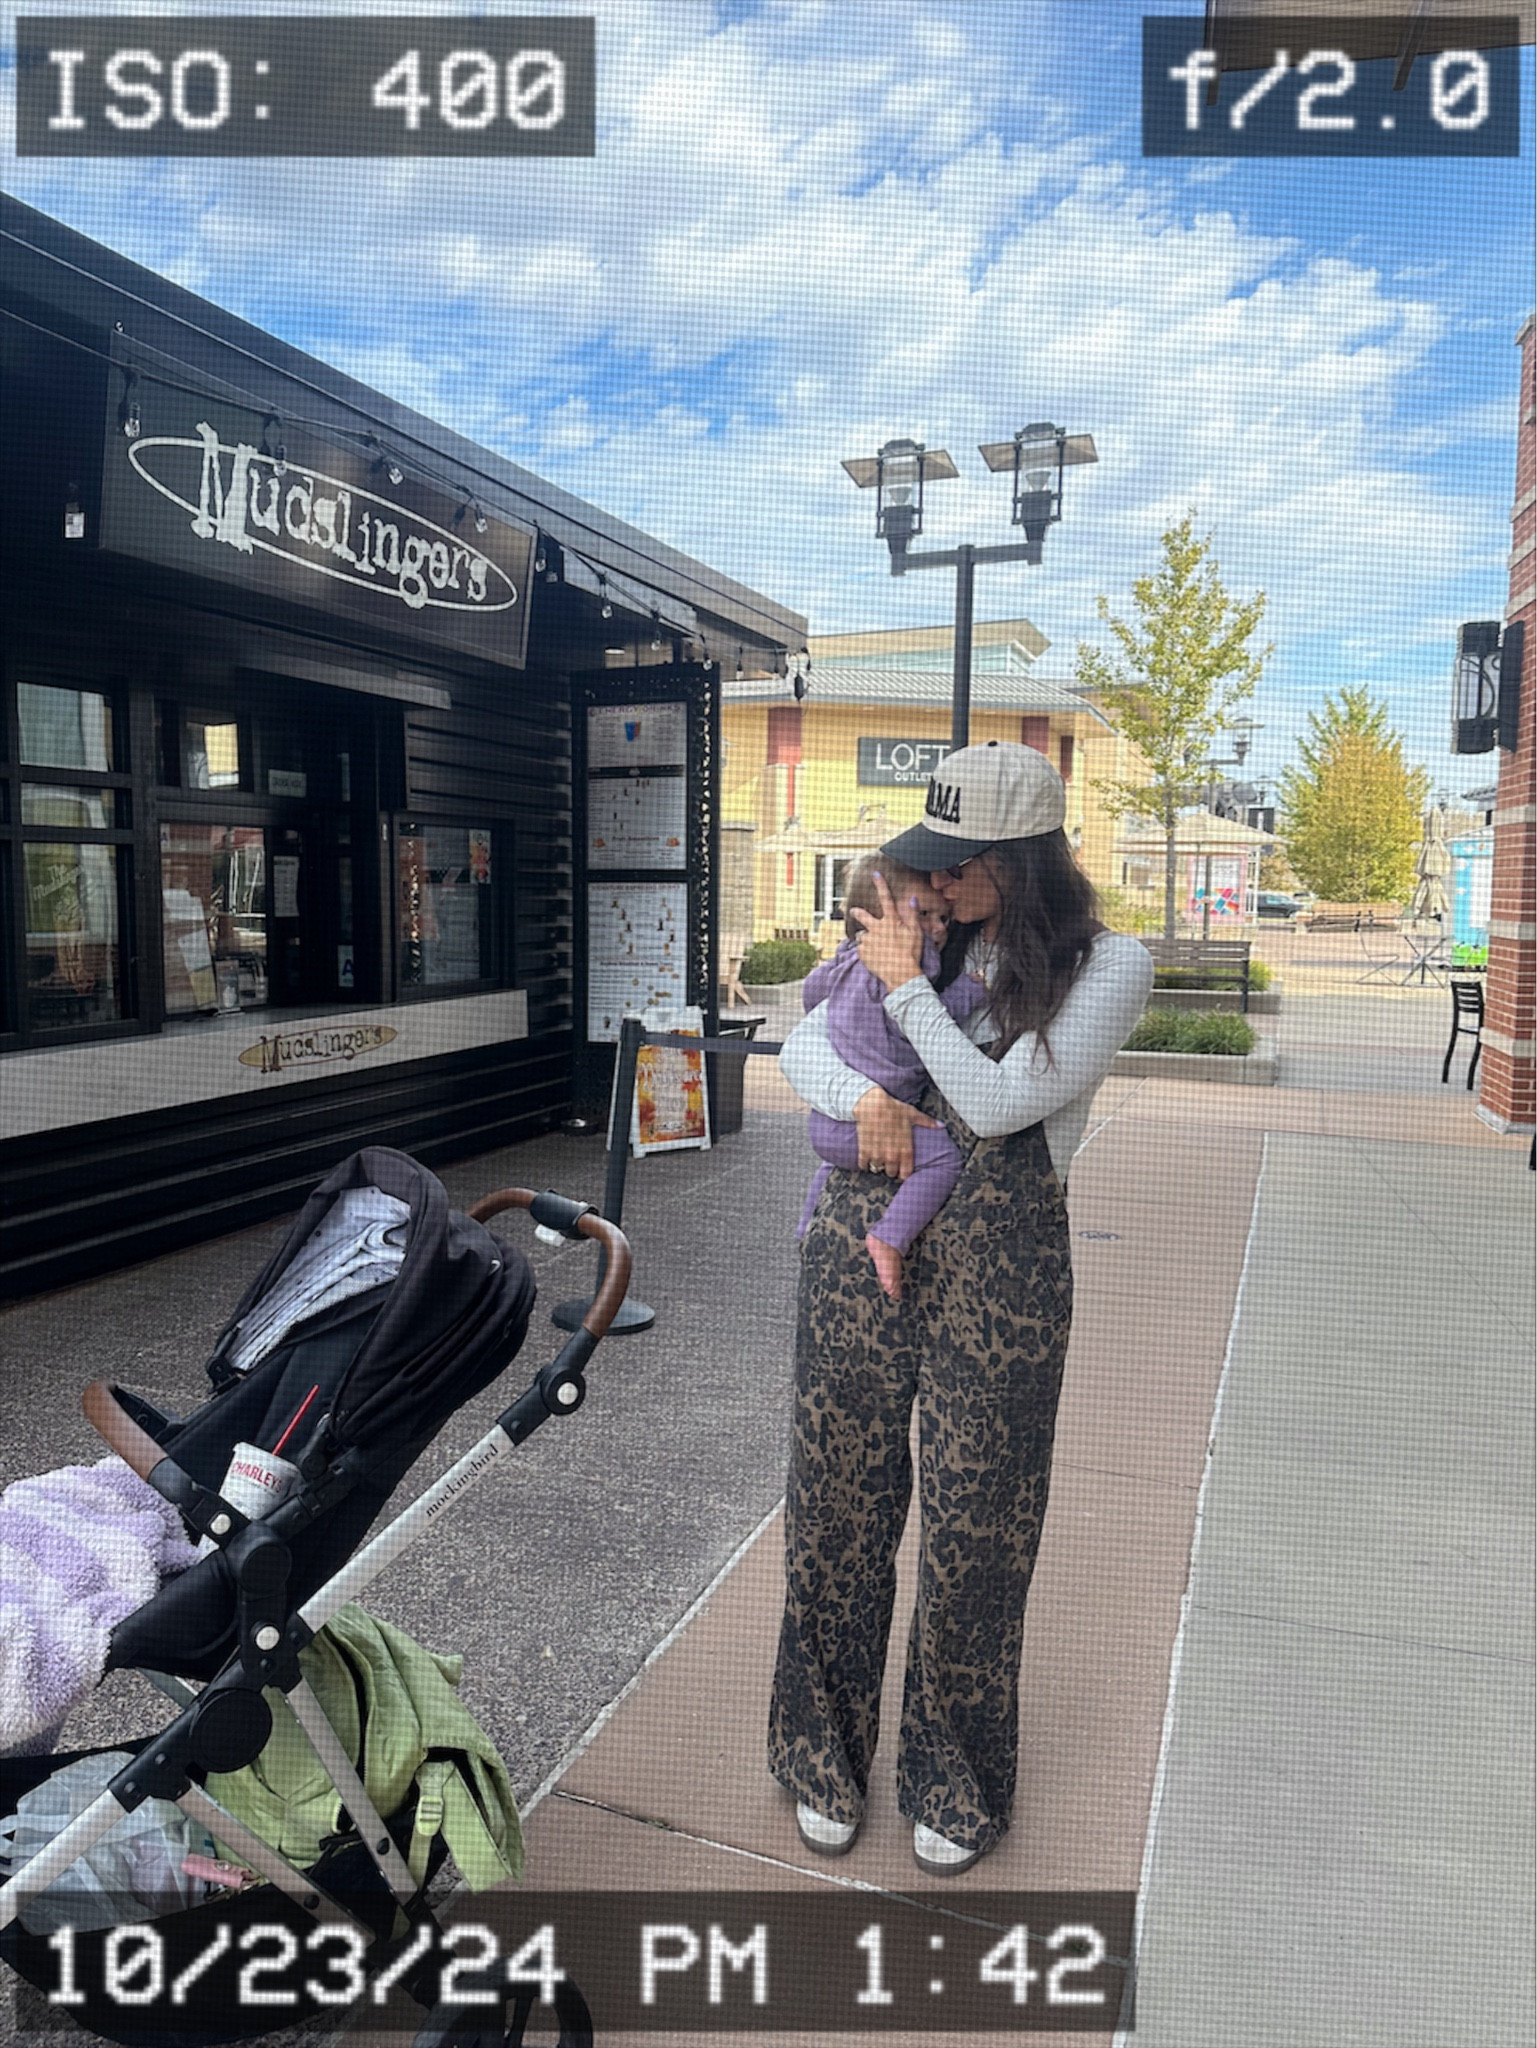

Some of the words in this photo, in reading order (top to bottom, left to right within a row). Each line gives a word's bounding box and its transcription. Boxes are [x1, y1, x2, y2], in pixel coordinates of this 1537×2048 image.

[191, 421, 489, 609] Mudslingers
[876, 742, 951, 771] LOFT
[894, 771, 933, 782] OUTLET
[260, 1026, 383, 1074] Mudslingers
[230, 1461, 283, 1493] CHARLEYS
[426, 1443, 499, 1517] mockingbird
